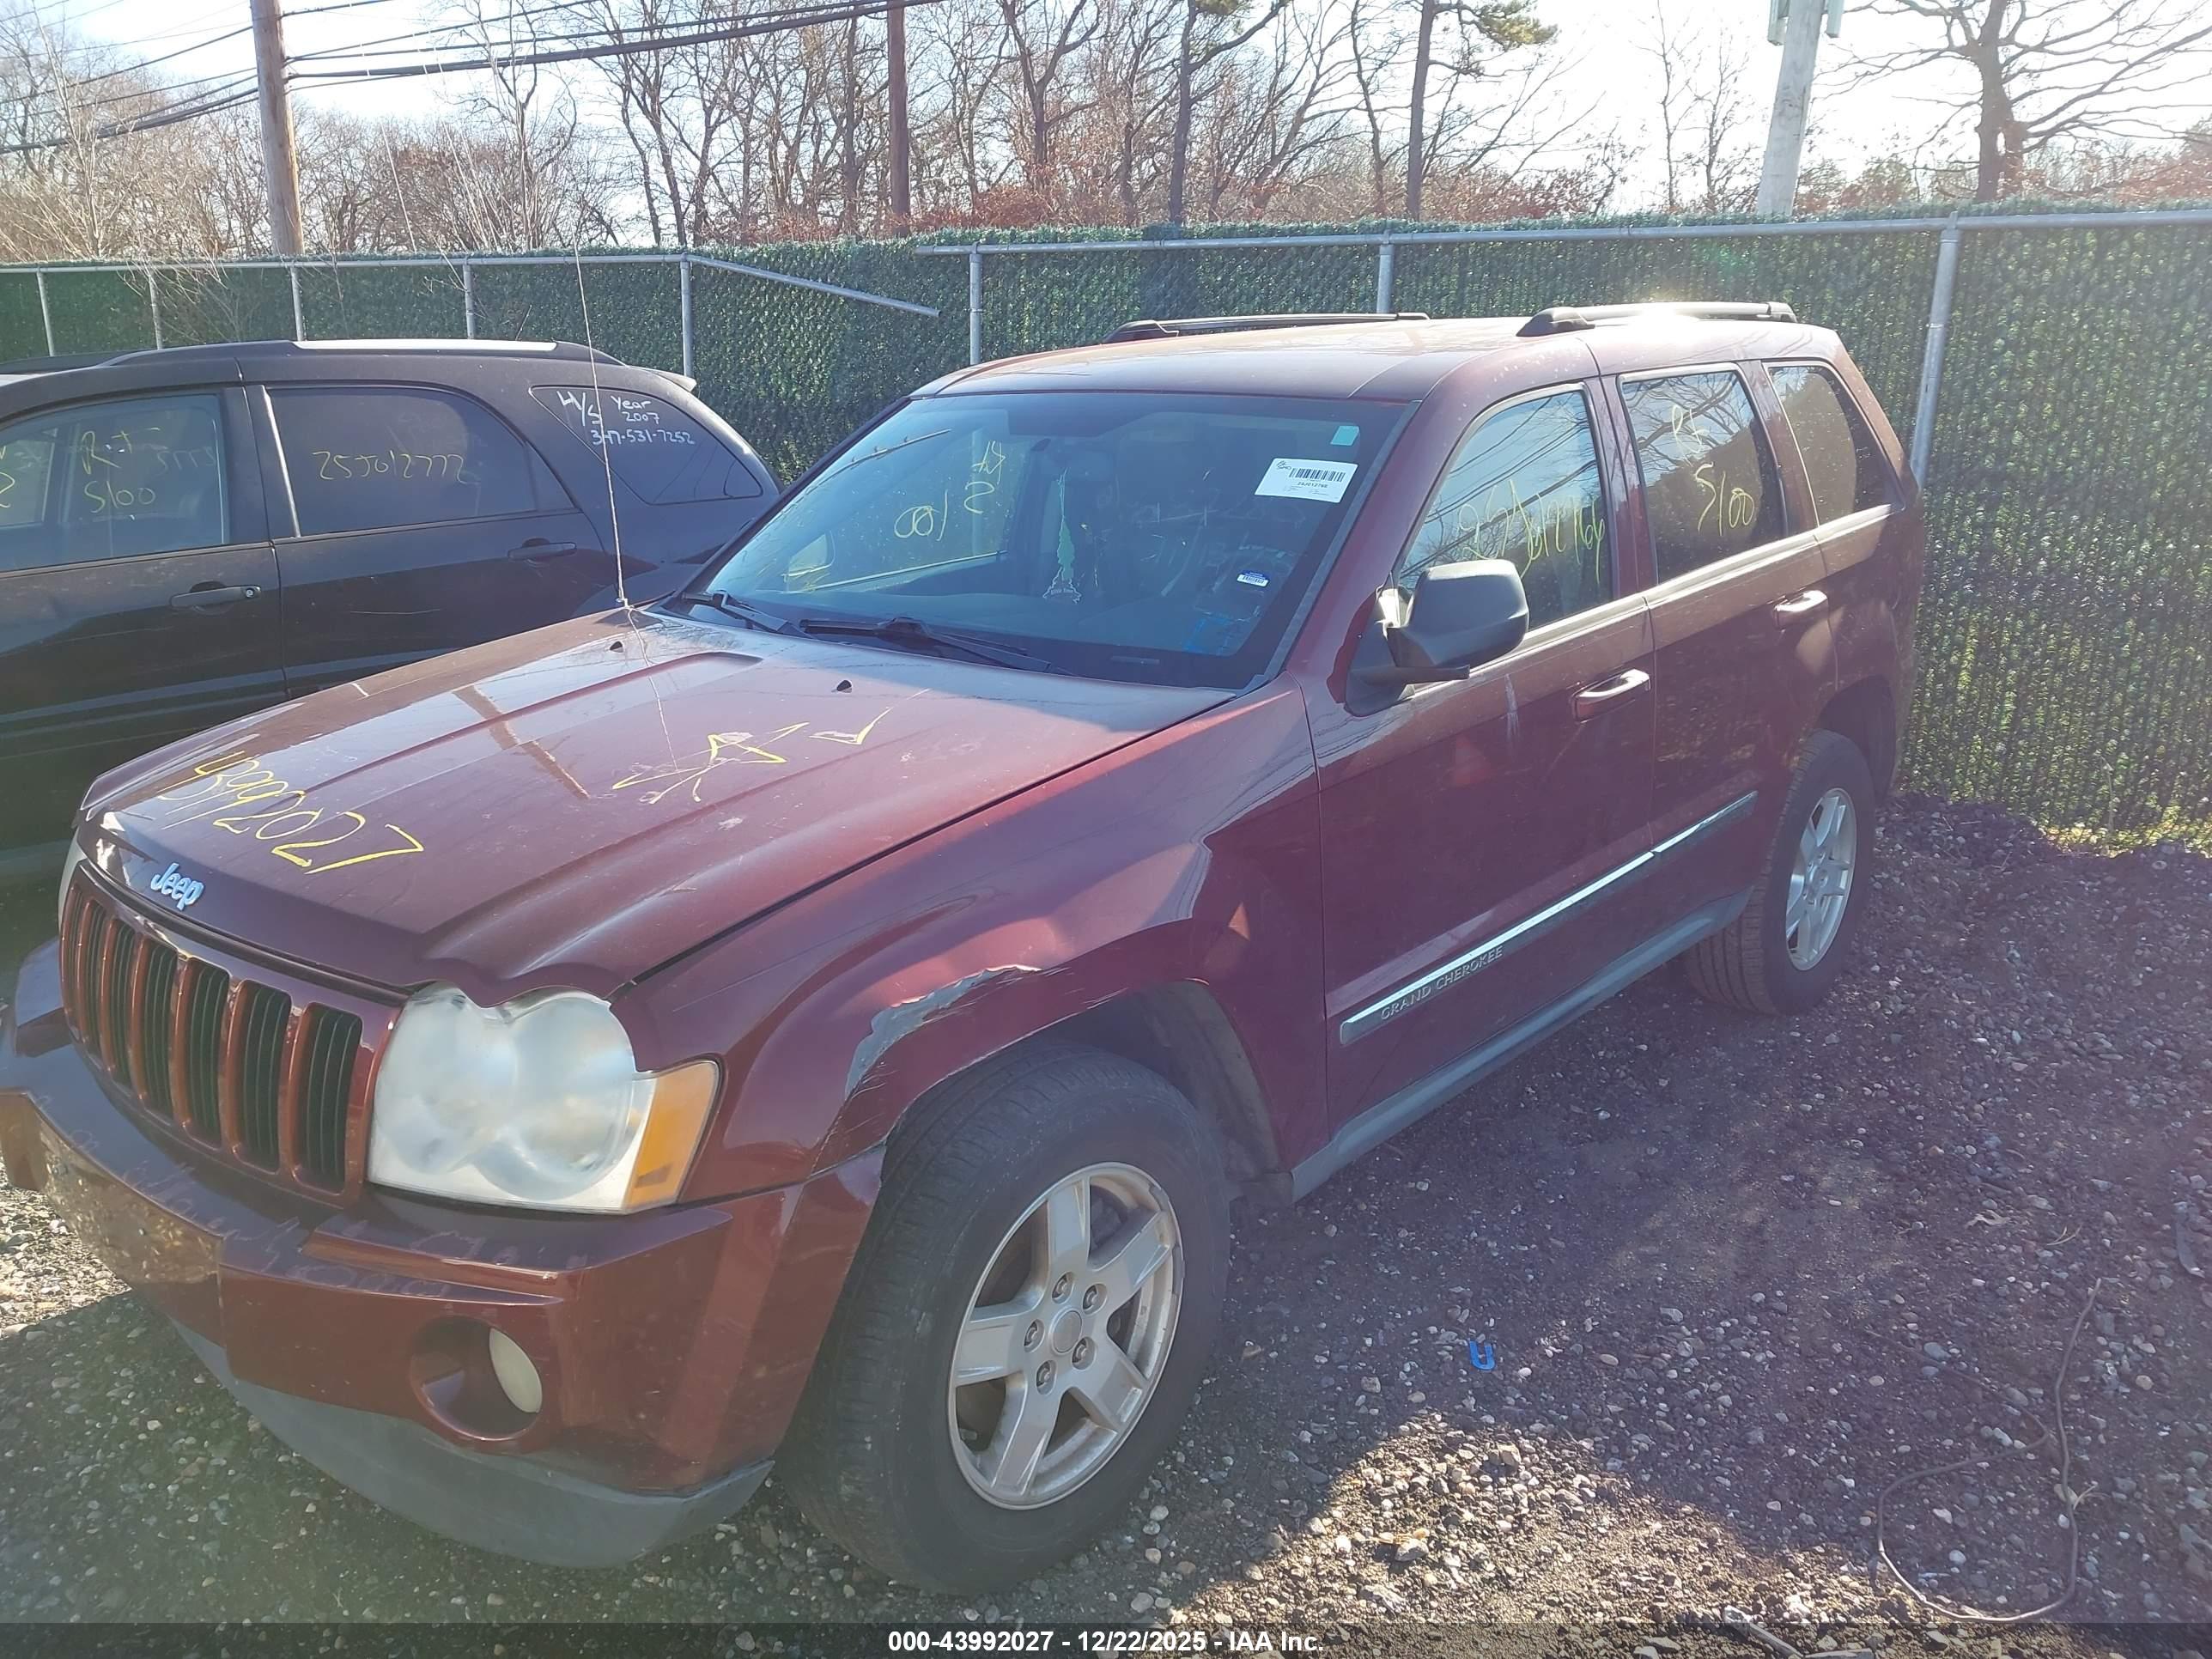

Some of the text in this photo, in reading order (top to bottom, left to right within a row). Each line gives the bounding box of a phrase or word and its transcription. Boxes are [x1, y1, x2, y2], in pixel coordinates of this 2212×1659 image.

[611, 395, 651, 410] Year
[622, 411, 659, 424] 2007
[150, 862, 206, 910] Jeep
[1381, 945, 1504, 1020] GRAND CHEROKEE
